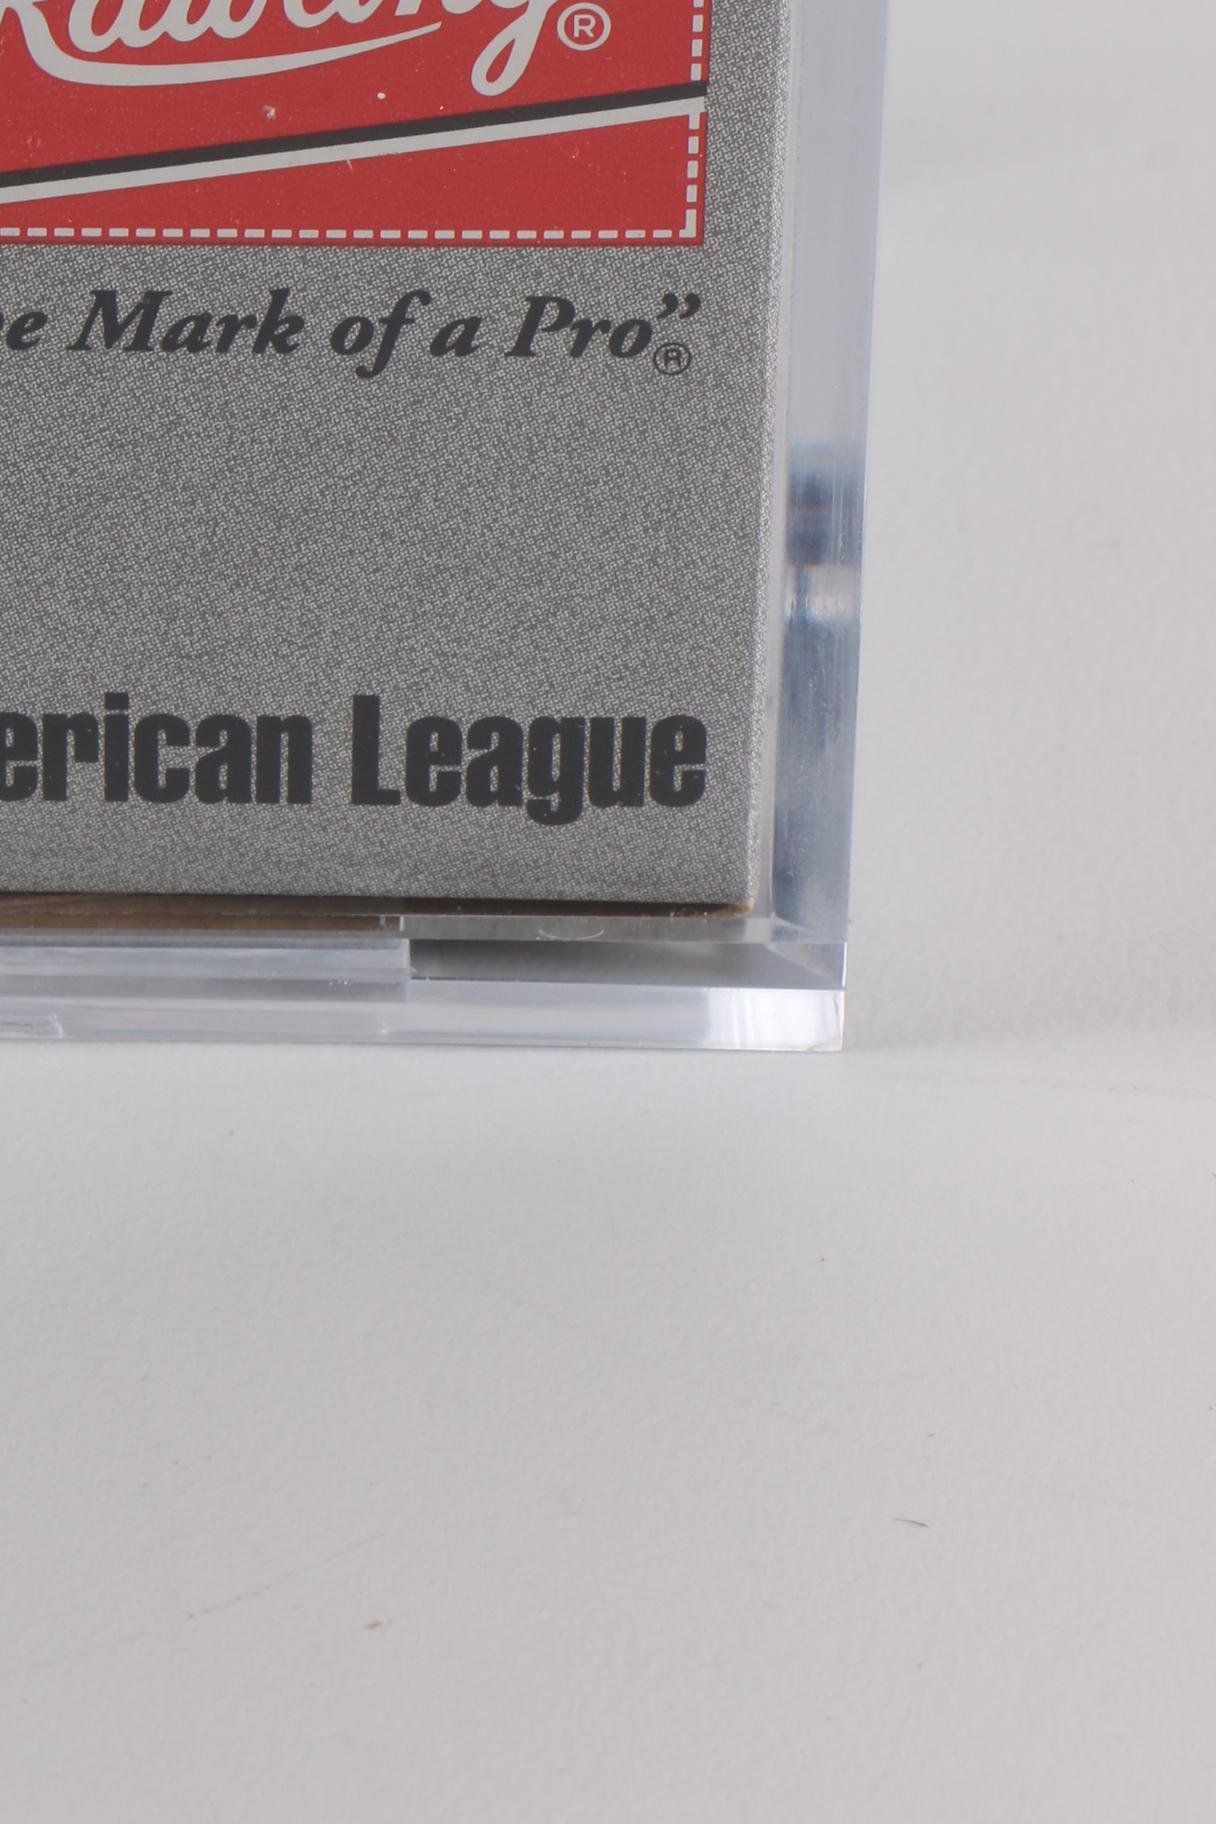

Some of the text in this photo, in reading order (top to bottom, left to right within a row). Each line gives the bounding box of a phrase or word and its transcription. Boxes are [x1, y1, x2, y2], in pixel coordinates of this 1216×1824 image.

[70, 288, 305, 358] Mark
[330, 290, 428, 377] of
[430, 316, 483, 360] a
[350, 693, 709, 826] League
